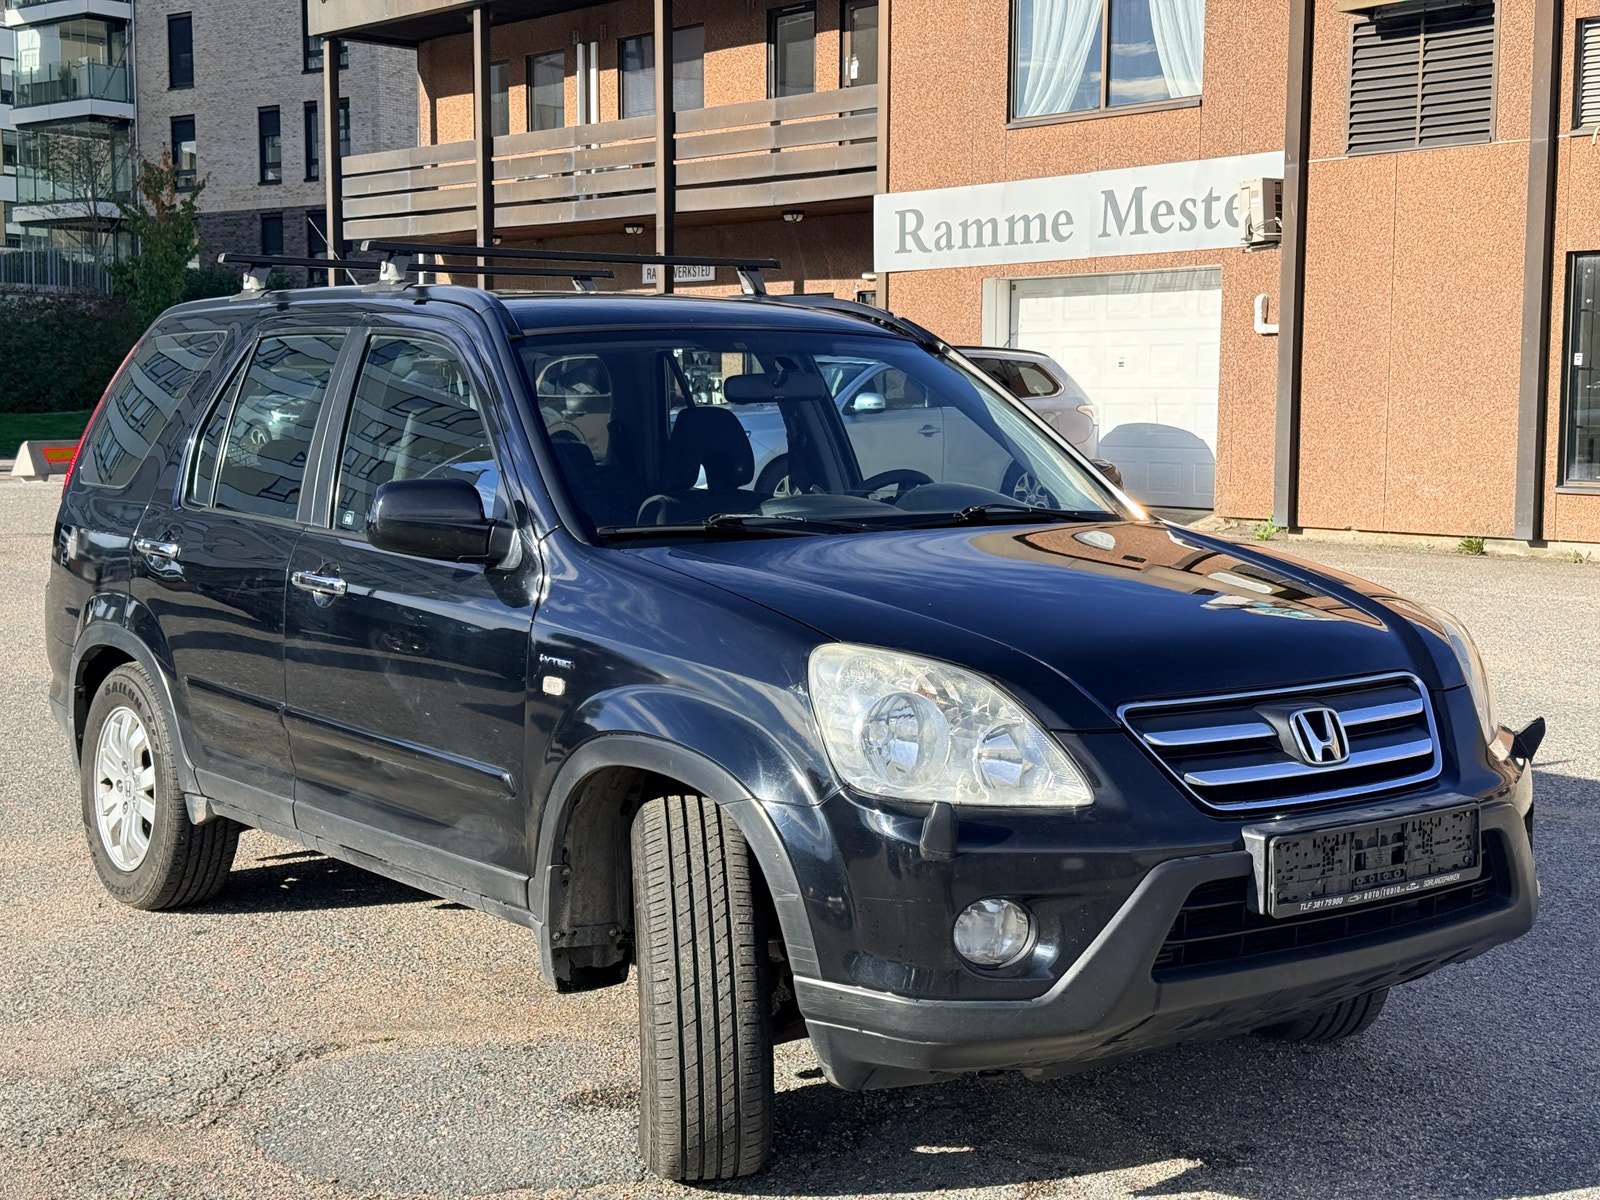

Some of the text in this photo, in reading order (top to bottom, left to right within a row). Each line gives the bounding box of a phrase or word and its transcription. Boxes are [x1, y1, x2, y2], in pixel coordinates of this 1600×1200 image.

[894, 185, 1239, 254] Ramme Meste
[104, 681, 142, 711] SAILUN
[1299, 901, 1312, 911] TLF
